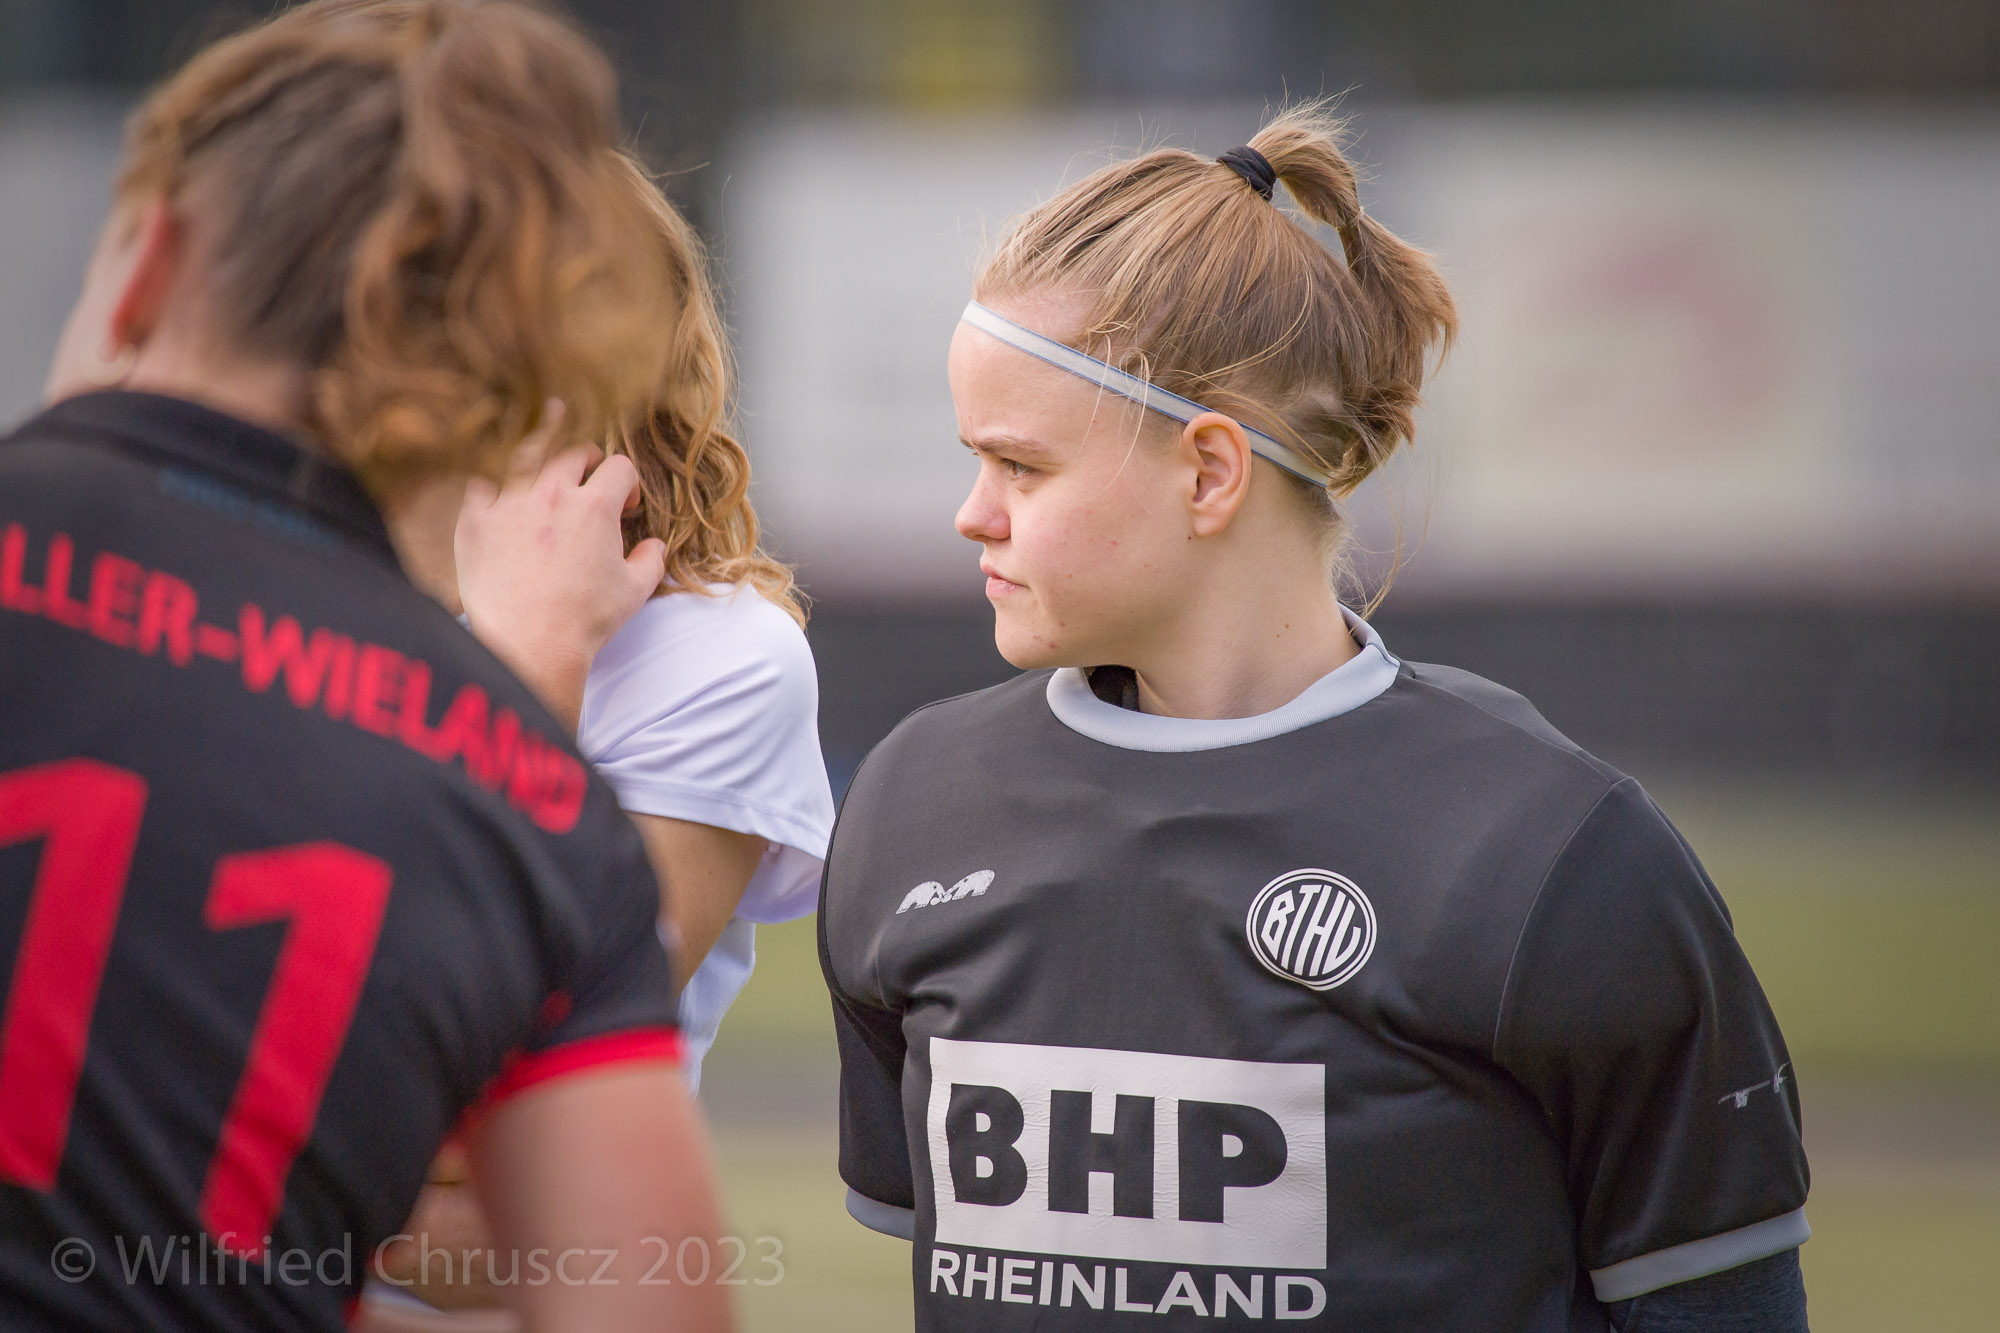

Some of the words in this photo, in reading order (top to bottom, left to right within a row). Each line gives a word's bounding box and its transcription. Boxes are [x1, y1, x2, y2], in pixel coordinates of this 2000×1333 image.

[0, 757, 394, 1265] 11
[945, 1082, 1288, 1224] BHP
[930, 1248, 1328, 1321] RHEINLAND
